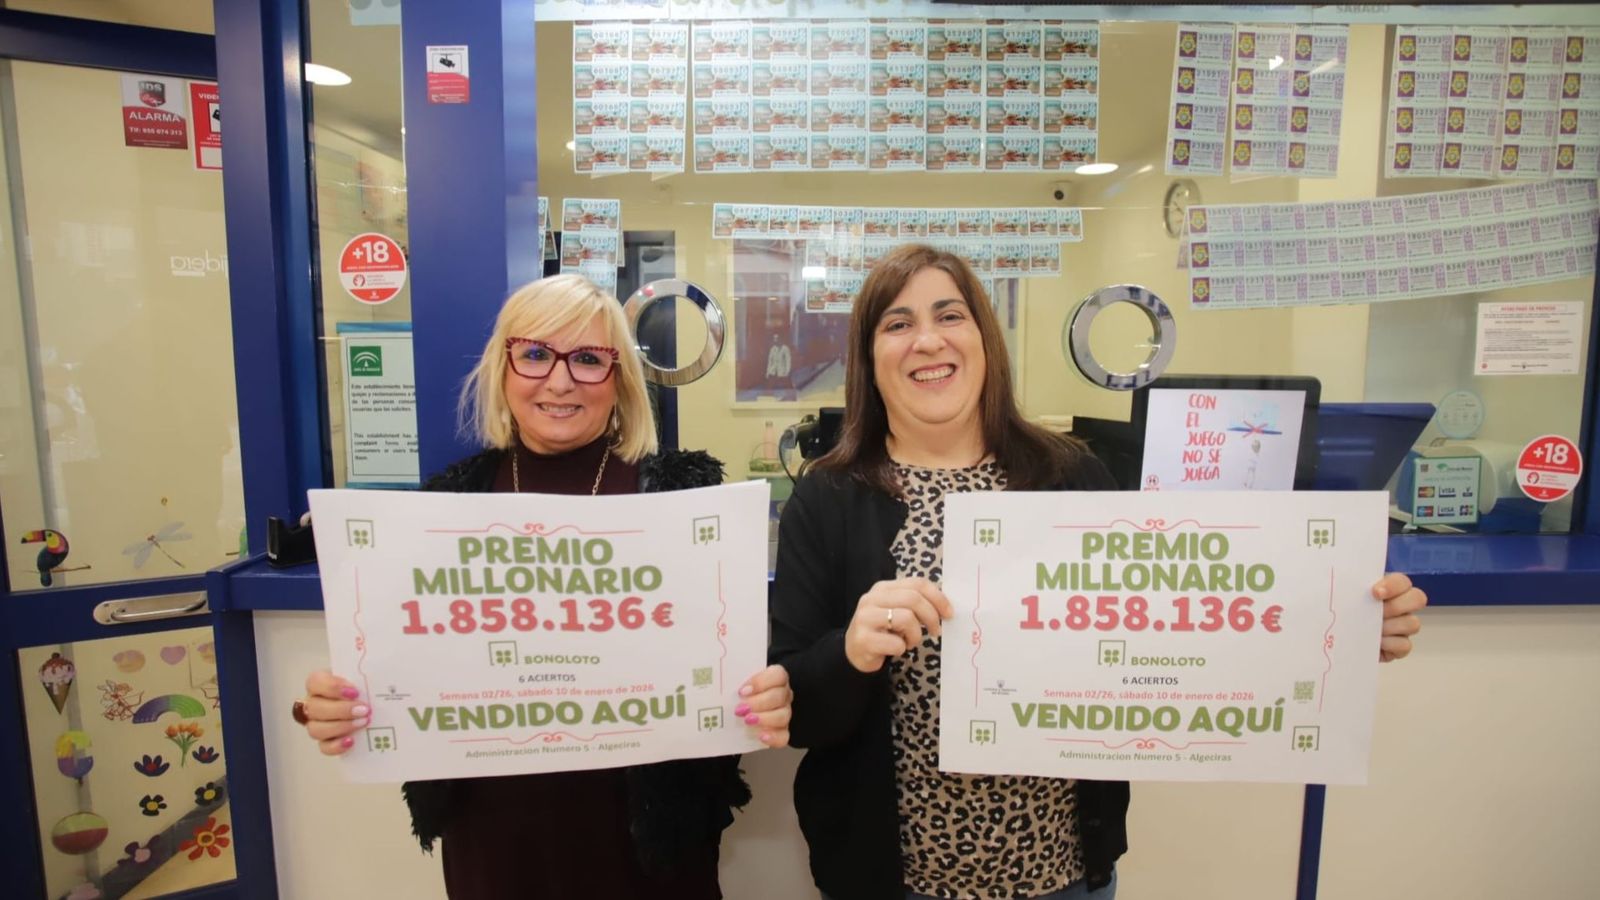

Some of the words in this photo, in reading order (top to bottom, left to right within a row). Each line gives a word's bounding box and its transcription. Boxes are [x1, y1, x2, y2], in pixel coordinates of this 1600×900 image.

[129, 111, 180, 123] ALARMA
[352, 241, 390, 264] +18
[1188, 393, 1216, 410] CON
[1185, 431, 1226, 446] JUEGO
[1182, 450, 1203, 464] NO
[1208, 449, 1221, 464] SE
[1533, 442, 1569, 464] +18
[1181, 467, 1220, 482] JUEGA
[458, 536, 613, 565] PREMIO
[1082, 532, 1229, 560] PREMIO
[413, 564, 662, 595] MILLONARIO
[1036, 563, 1275, 592] MILLONARIO
[524, 654, 600, 665] BONOLOTO
[1130, 656, 1206, 668] BONOLOTO
[527, 674, 576, 683] ACIERTOS
[1122, 676, 1128, 684] 6
[1130, 676, 1179, 685] ACIERTOS
[439, 691, 480, 700] Semana
[518, 687, 554, 697] sábado
[556, 688, 567, 696] 10
[569, 686, 582, 696] de
[584, 688, 614, 696] enero
[615, 685, 628, 694] de
[630, 684, 654, 692] 2026
[1044, 689, 1082, 698] Semana
[1118, 689, 1154, 700] sábado
[1156, 691, 1168, 700] 10
[1170, 690, 1182, 700] de
[1185, 692, 1212, 700] enero
[1214, 690, 1228, 700] de
[1230, 692, 1254, 701] 2026
[408, 701, 584, 732] VENDIDO
[592, 685, 686, 726] AQUÍ
[1012, 702, 1181, 732] VENDIDO
[1187, 698, 1285, 738] AQUÍ
[542, 744, 582, 754] Numero
[598, 740, 640, 752] Algeciras
[1133, 752, 1173, 762] Numero
[1175, 754, 1181, 762] 5
[1189, 753, 1232, 763] Algeciras
